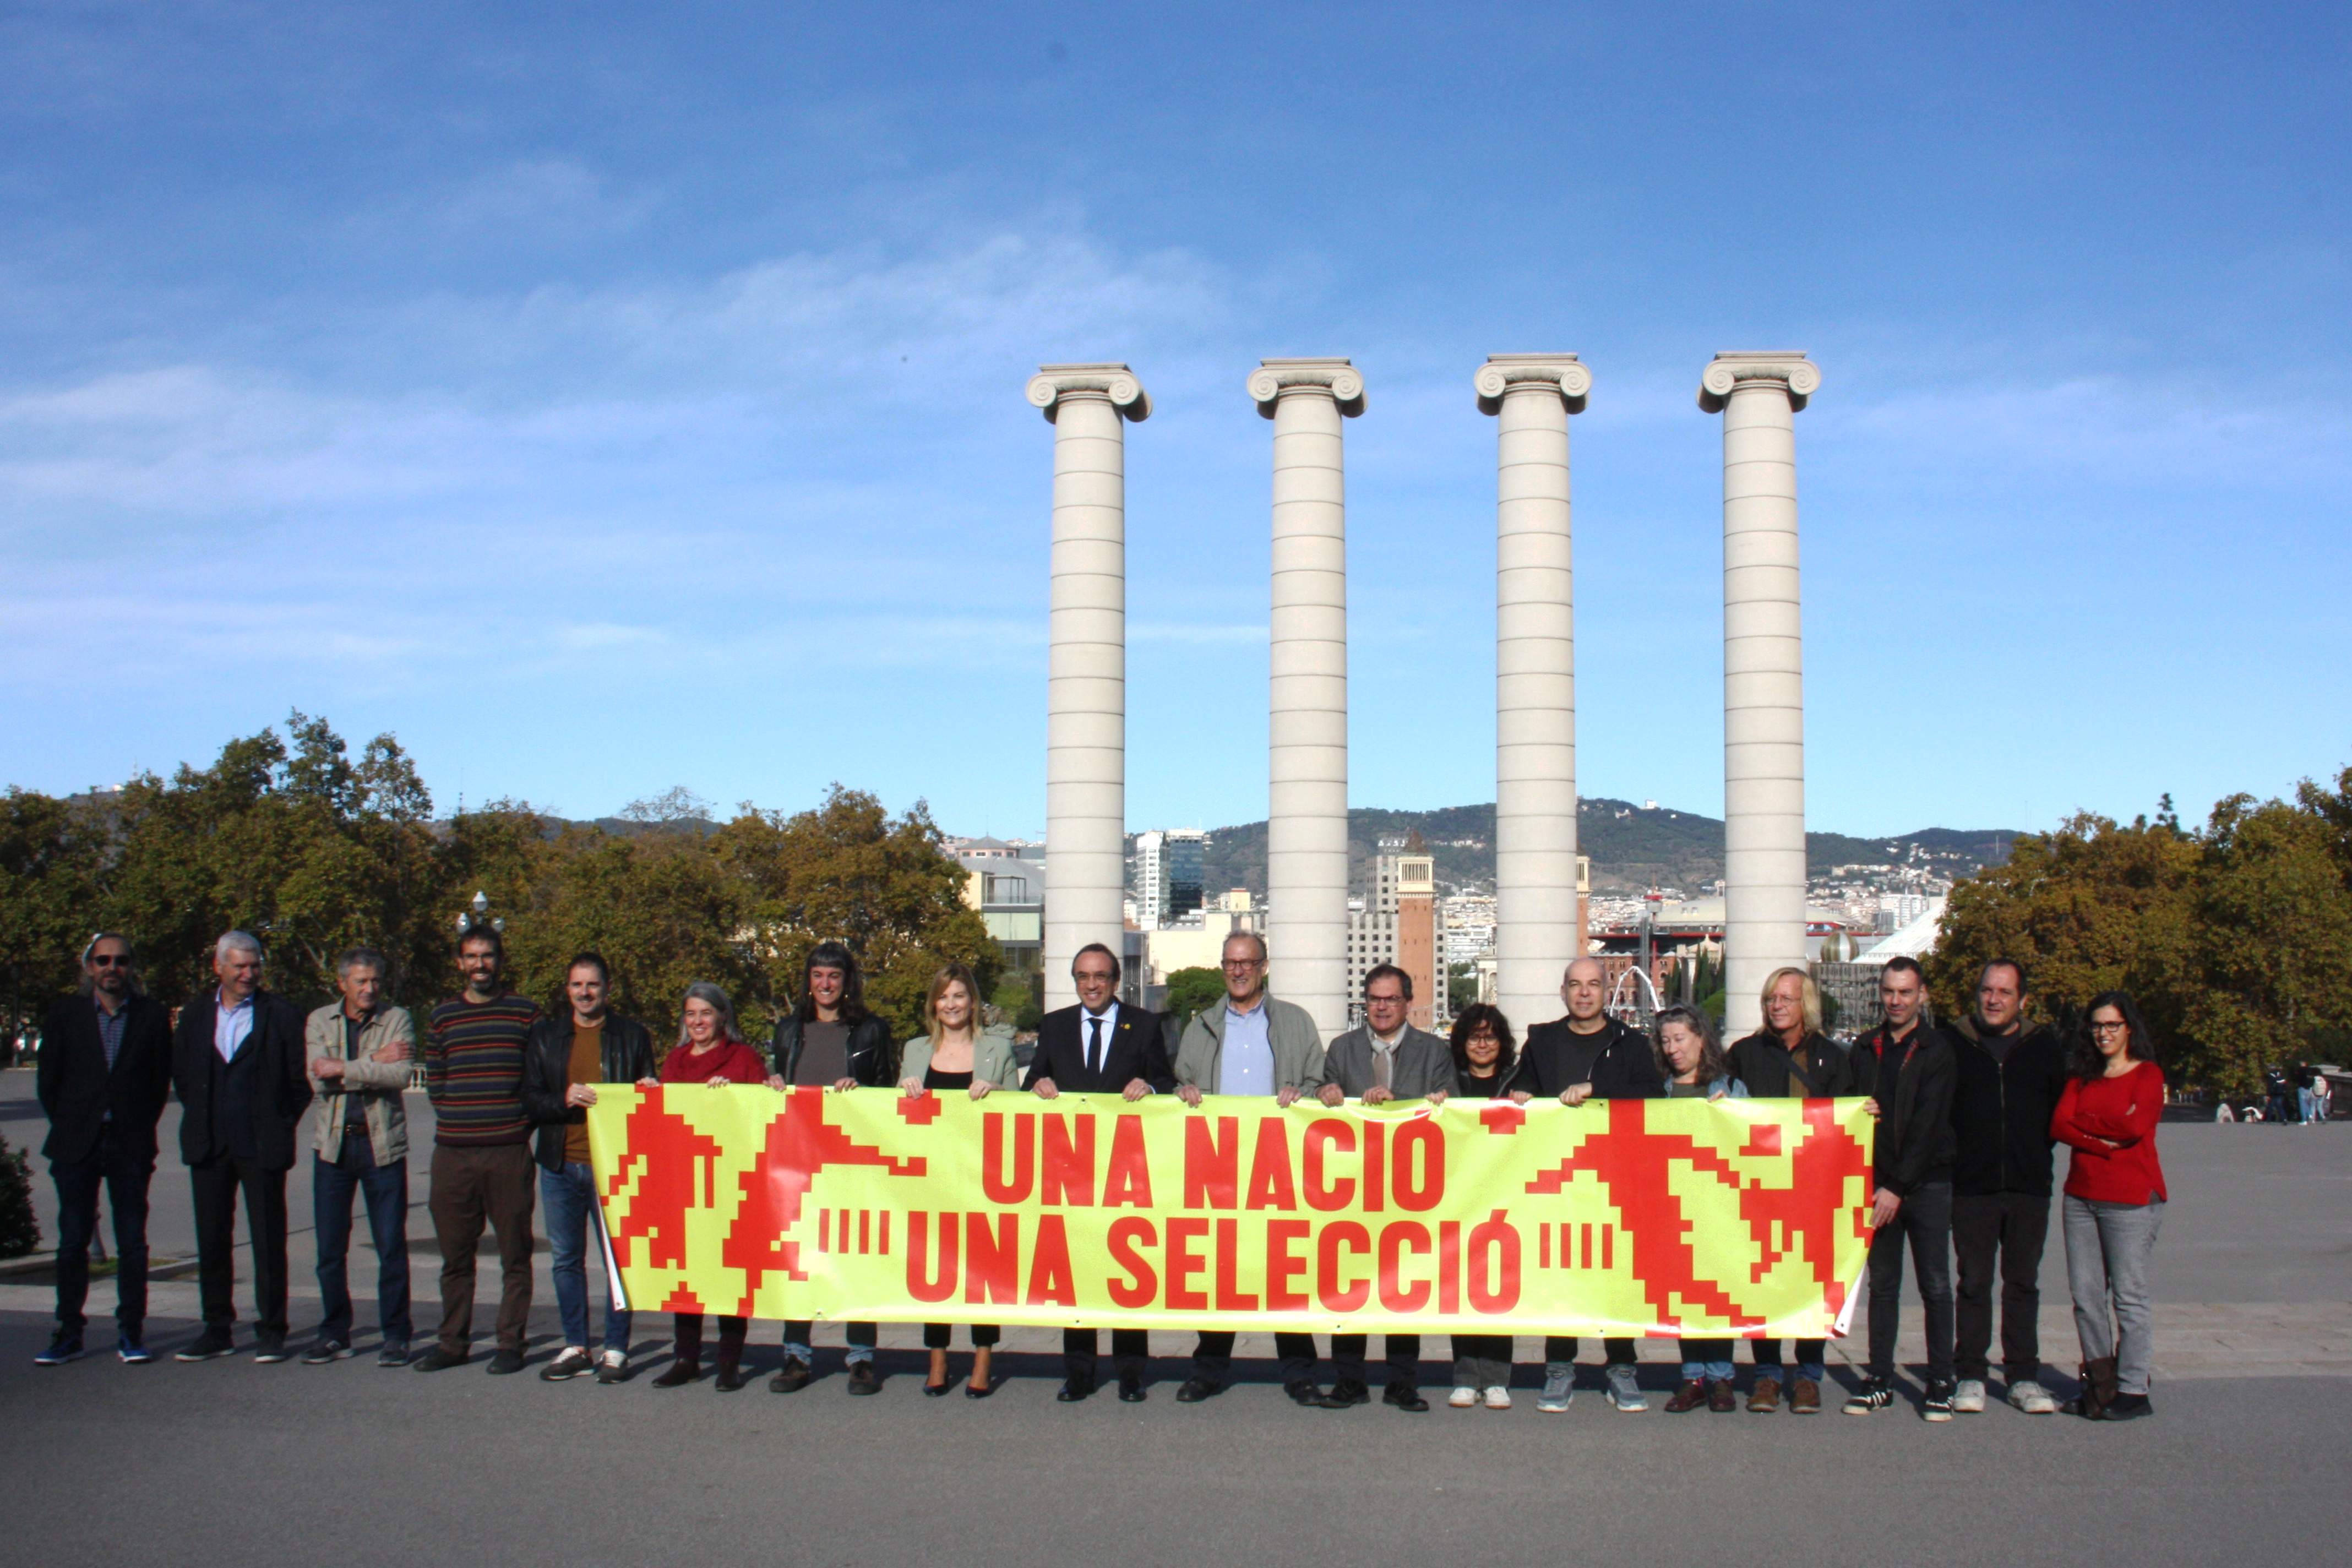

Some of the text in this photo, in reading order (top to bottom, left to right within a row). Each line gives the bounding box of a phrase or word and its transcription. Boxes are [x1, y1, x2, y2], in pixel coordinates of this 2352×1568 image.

[983, 1108, 1446, 1212] UNA NACIÓ
[907, 1209, 1521, 1314] UNA SELECCIÓ
